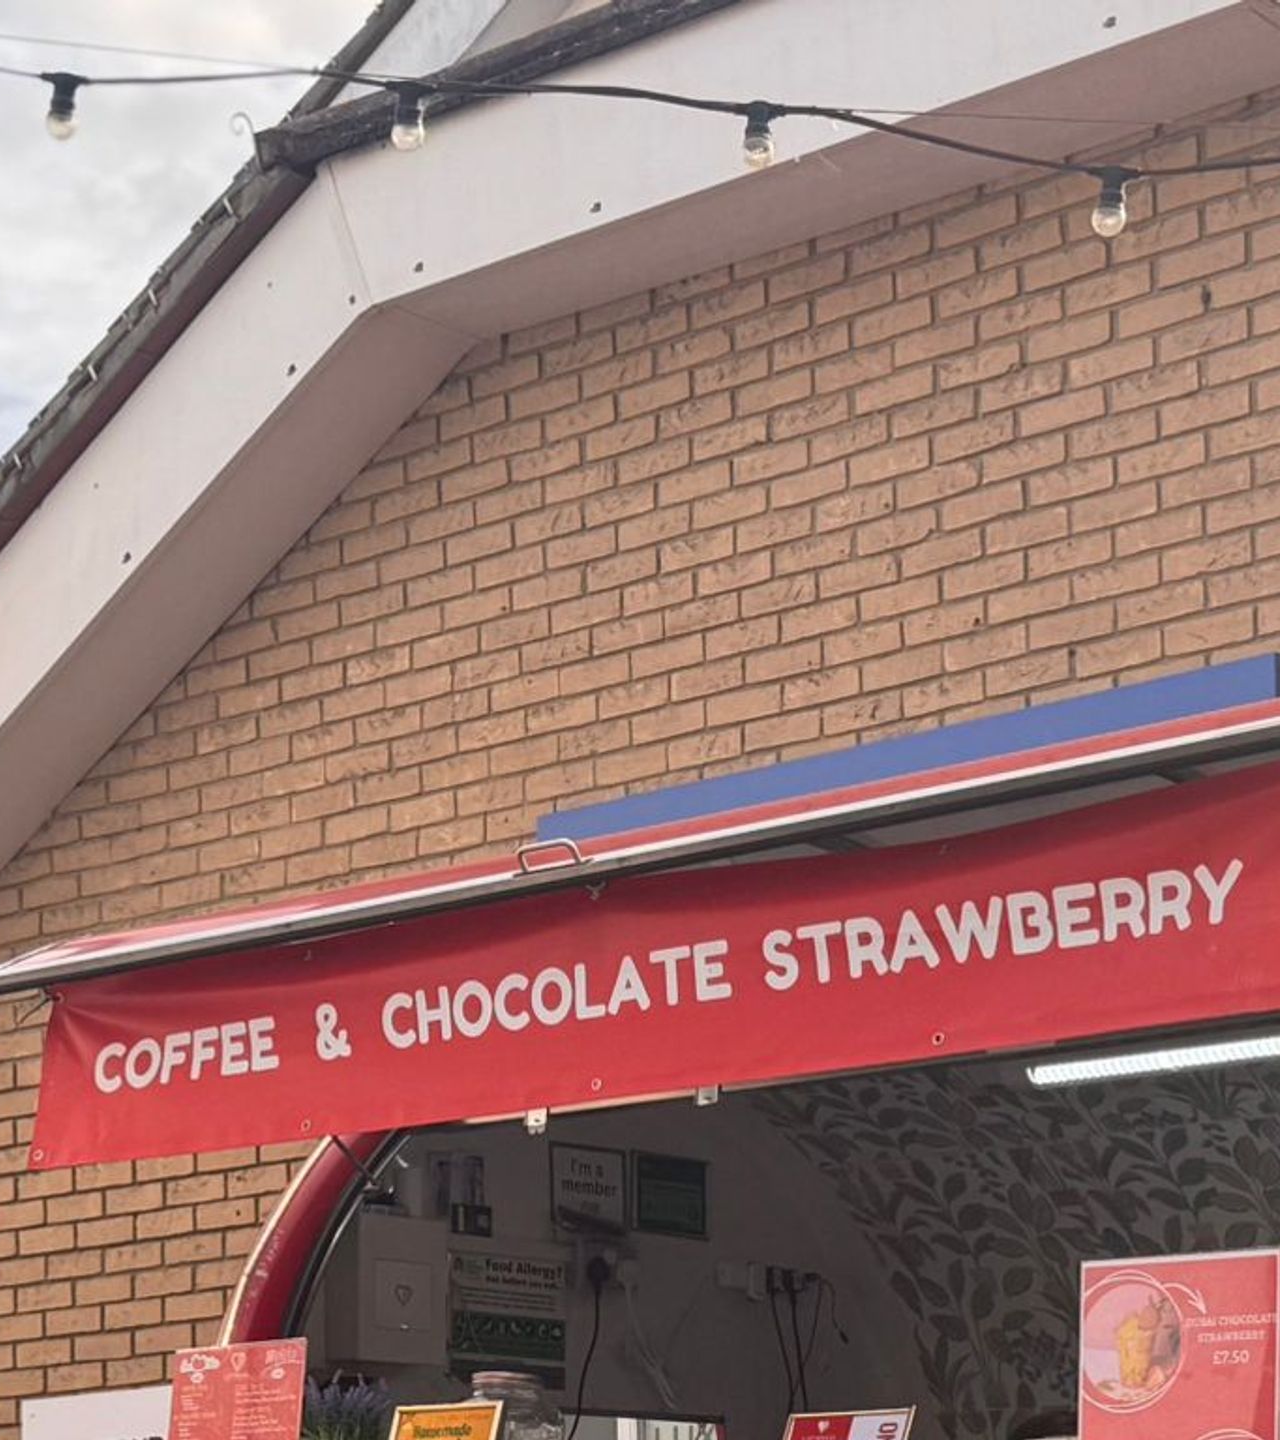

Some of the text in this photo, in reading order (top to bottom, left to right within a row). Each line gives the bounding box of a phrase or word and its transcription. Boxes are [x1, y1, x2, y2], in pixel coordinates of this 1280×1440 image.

[94, 859, 1244, 1094] COFFEE & CHOCOLATE STRAWBERRY
[561, 1179, 618, 1198] member
[1213, 1350, 1250, 1365] £7.50
